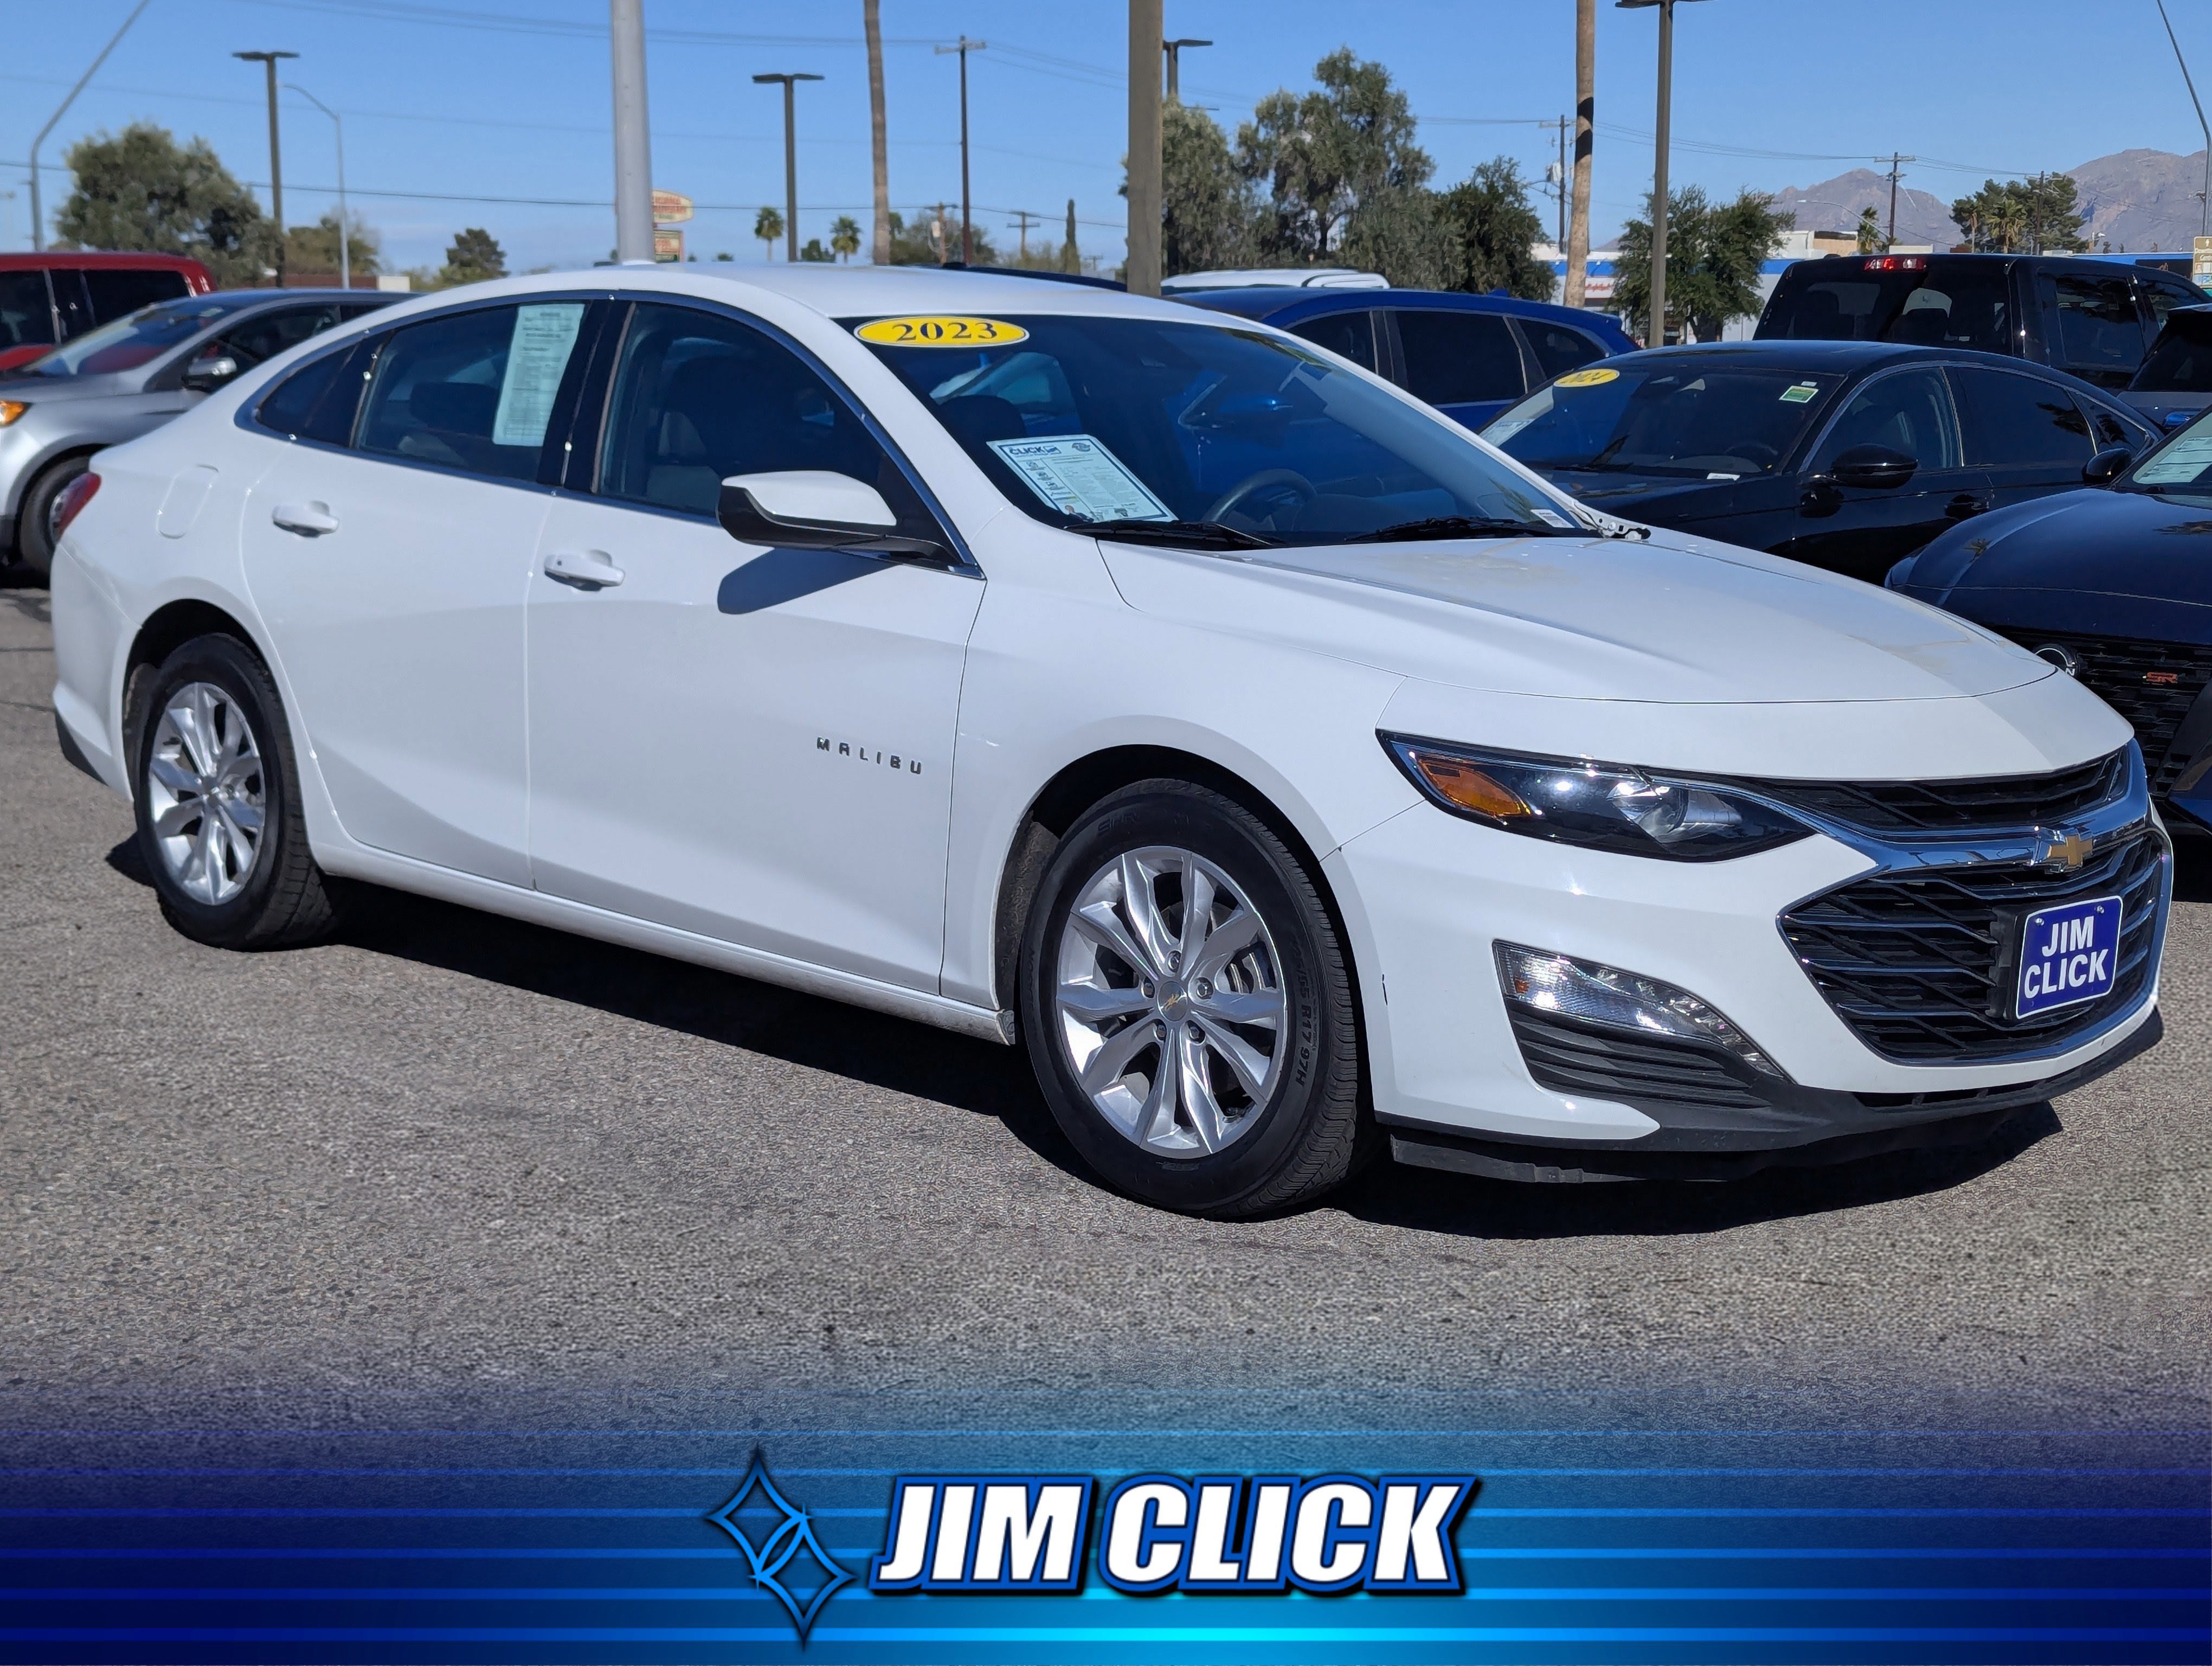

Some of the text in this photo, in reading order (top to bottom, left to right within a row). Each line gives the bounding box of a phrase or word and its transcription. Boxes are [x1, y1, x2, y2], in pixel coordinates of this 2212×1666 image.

[892, 322, 998, 341] 2023
[817, 737, 922, 774] MALIBU
[2042, 916, 2094, 957] JIM
[2024, 949, 2108, 998] CLICK
[1295, 1047, 1310, 1087] 97H
